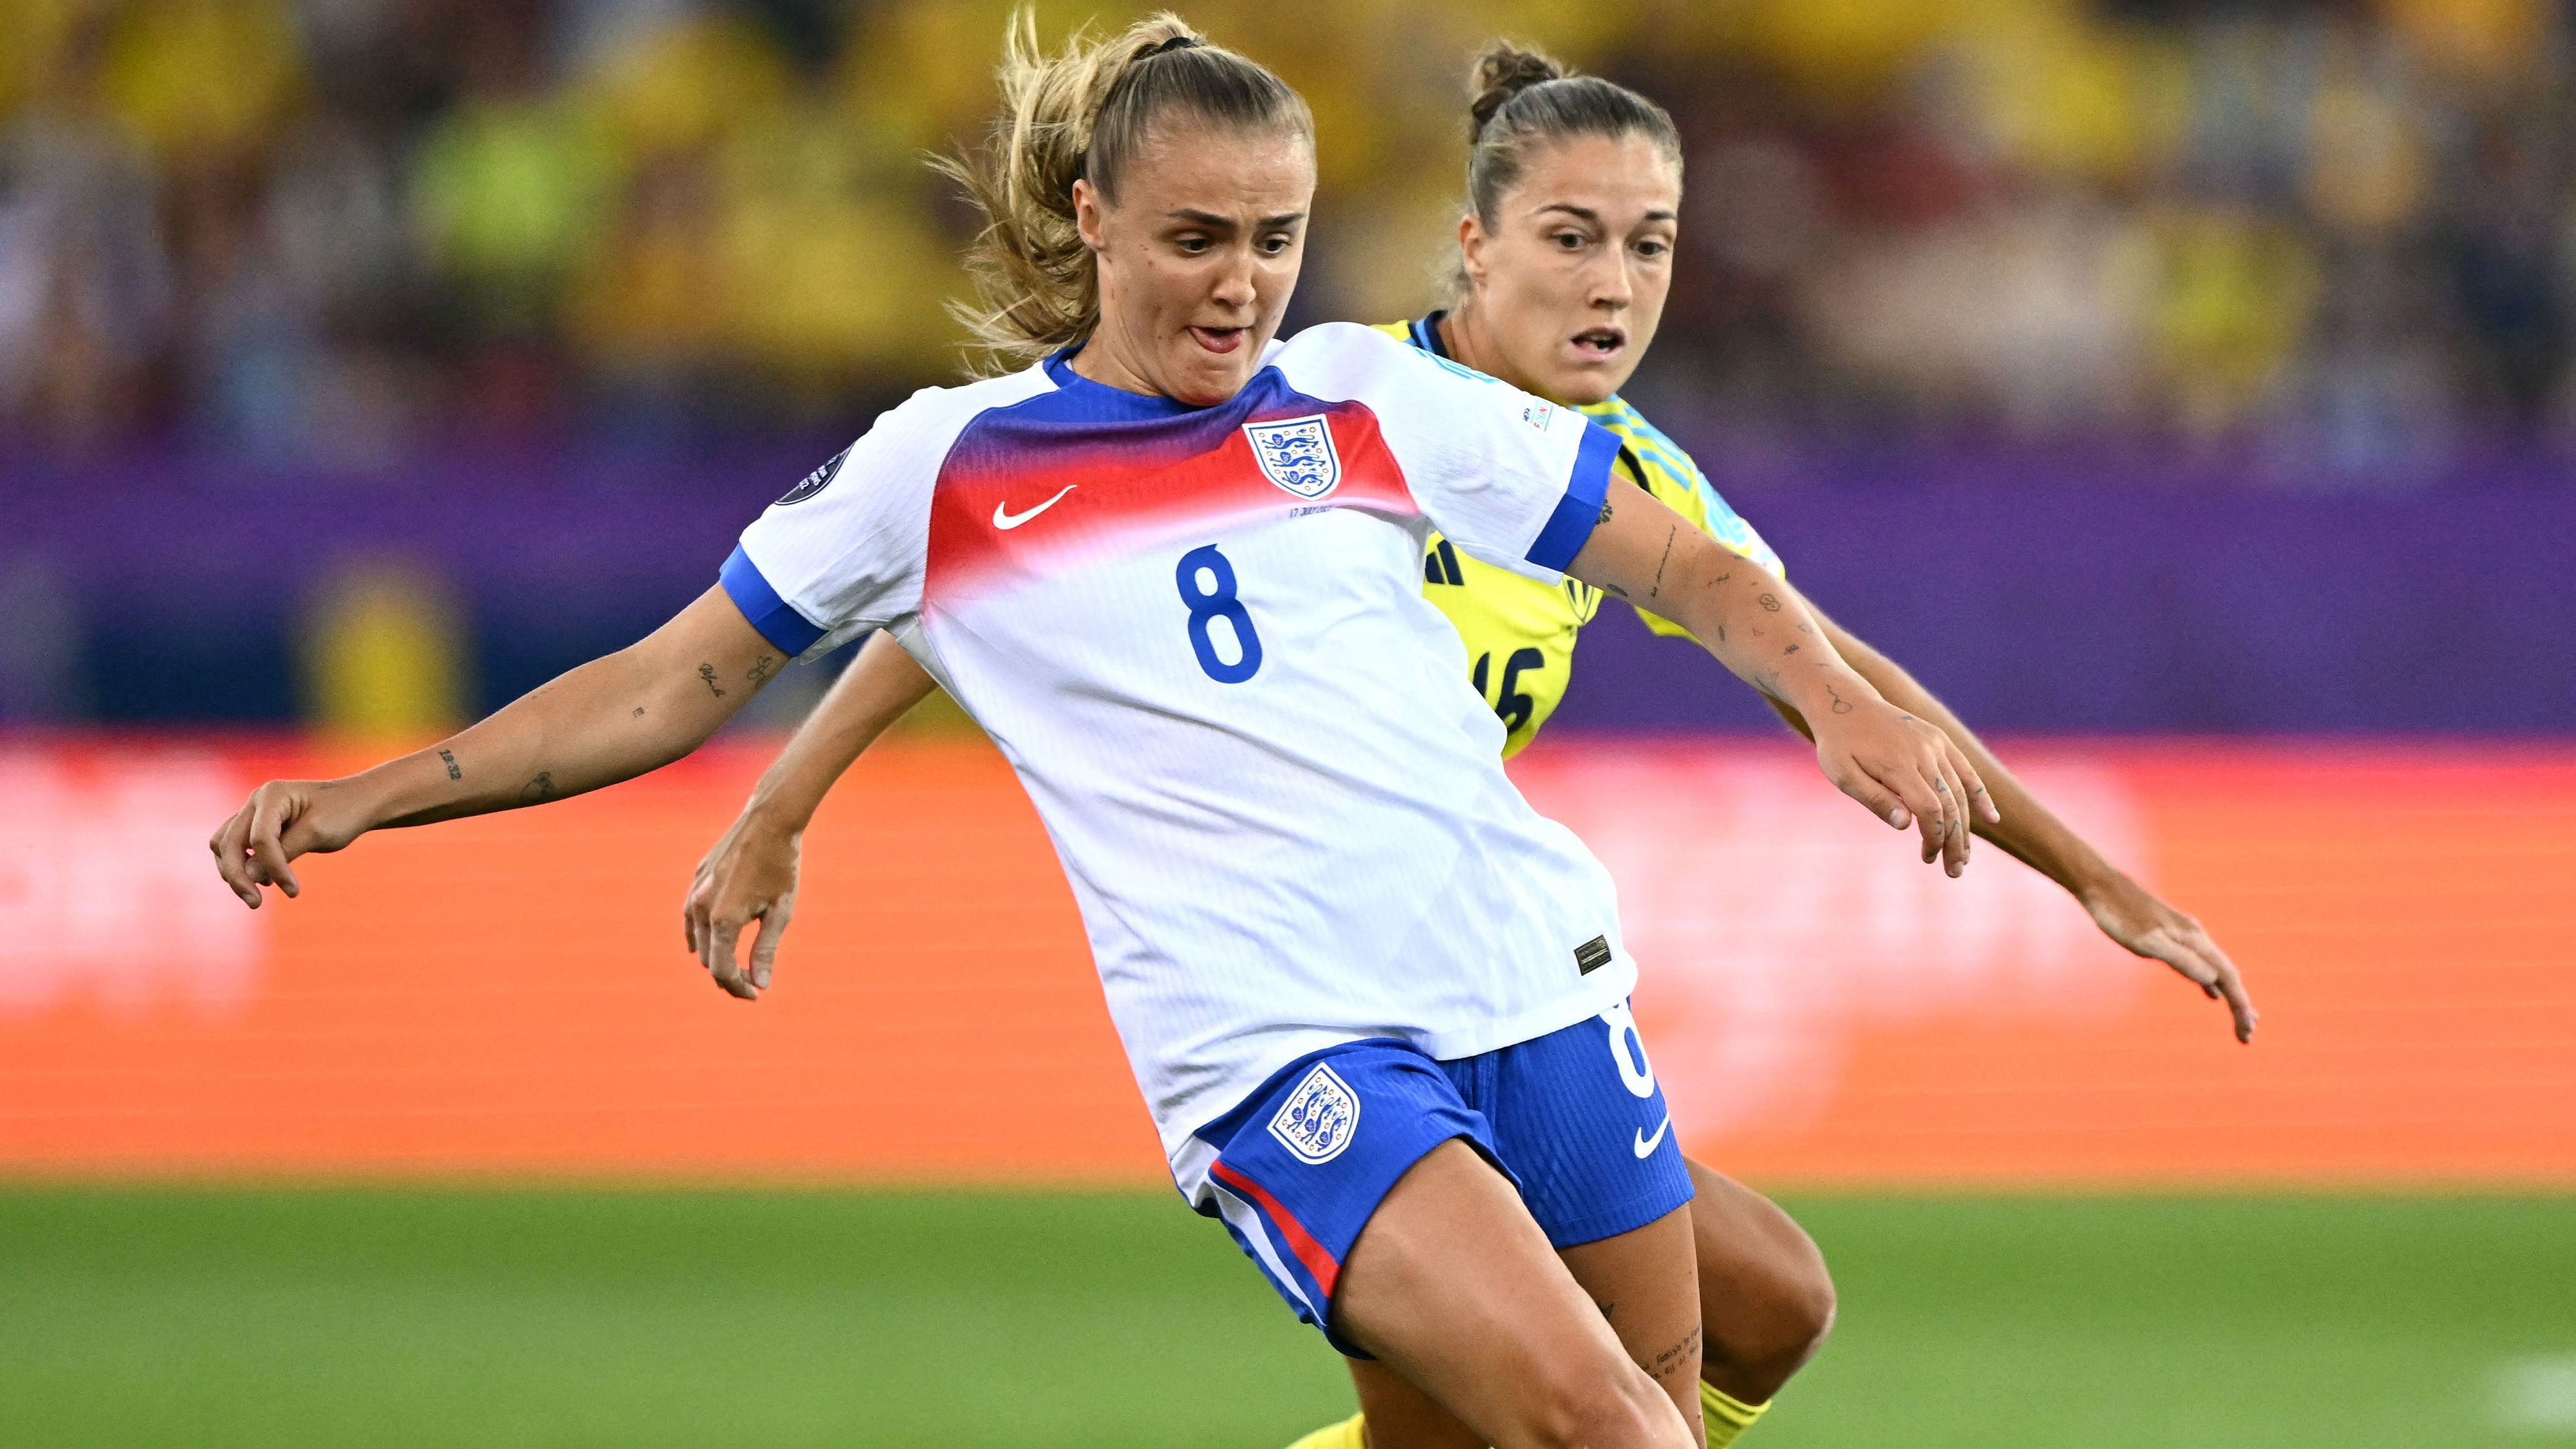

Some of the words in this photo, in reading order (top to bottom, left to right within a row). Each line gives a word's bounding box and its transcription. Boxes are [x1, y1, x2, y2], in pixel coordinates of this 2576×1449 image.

[1290, 508, 1299, 519] 17
[1176, 543, 1263, 684] 8
[1472, 647, 1545, 736] 16
[1598, 999, 1655, 1098] 8
